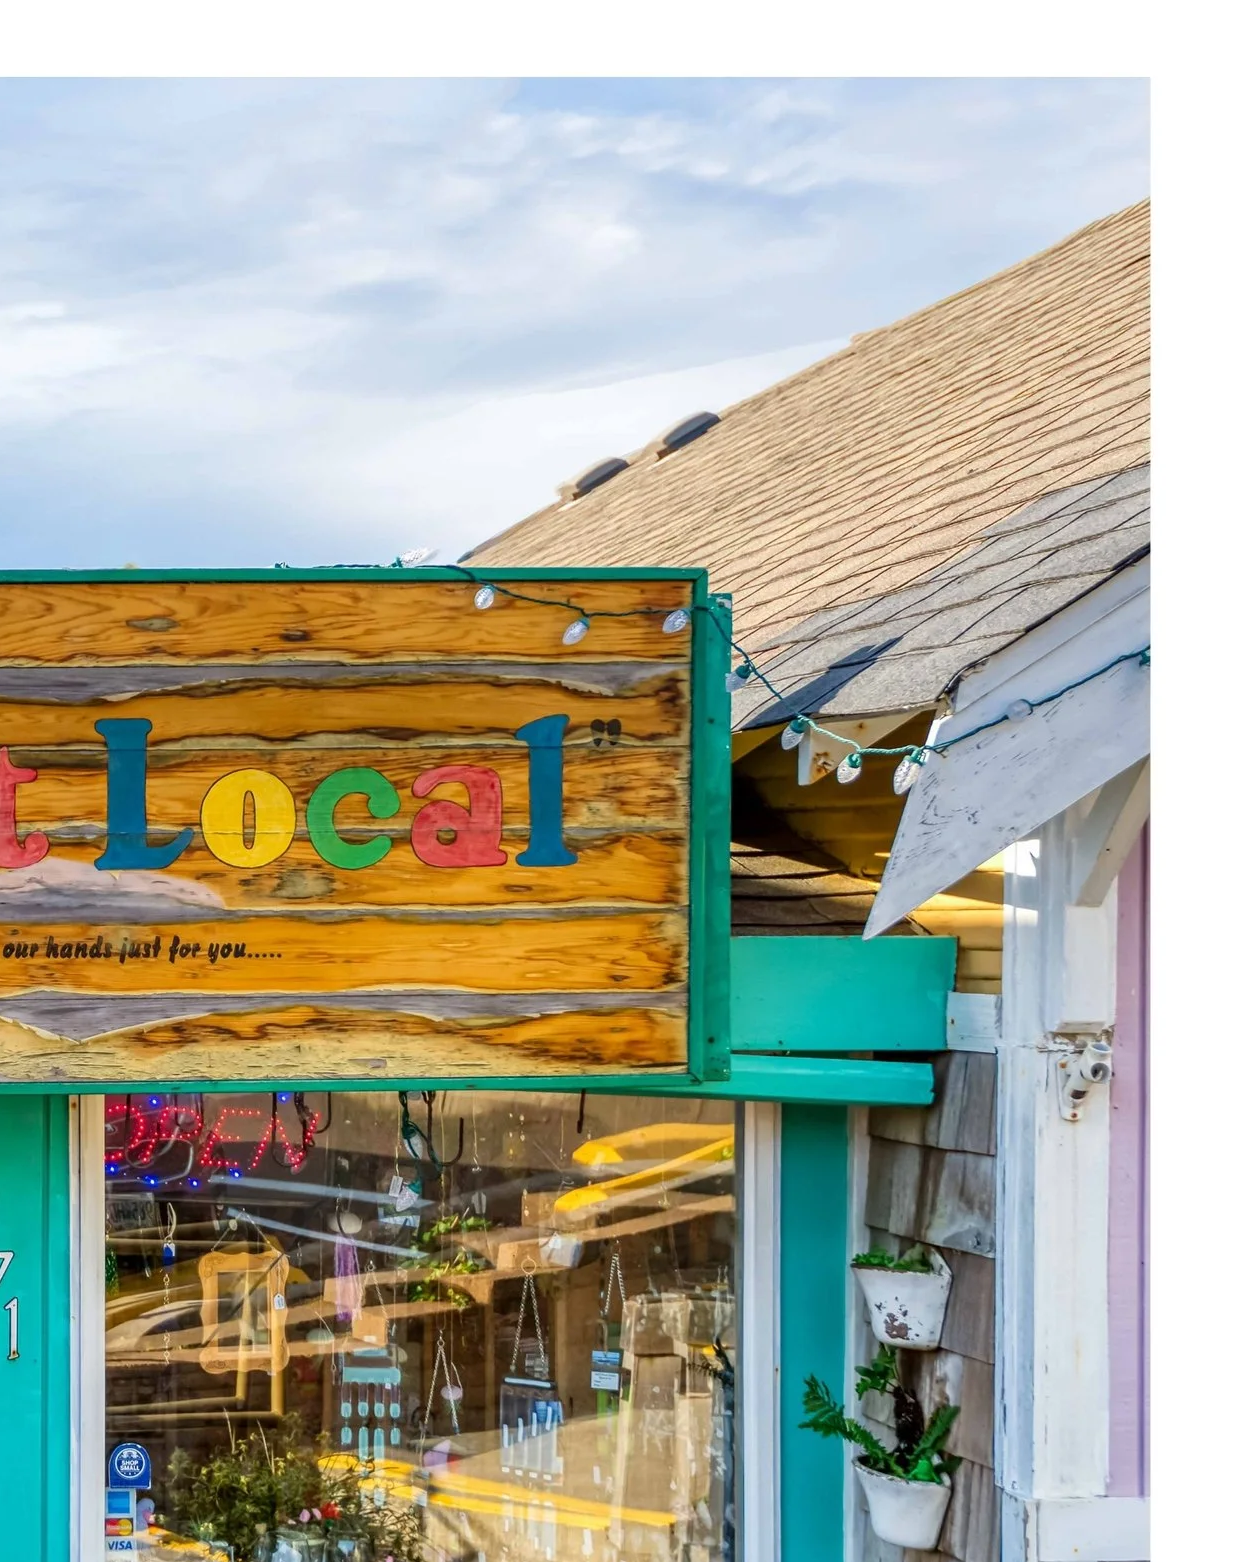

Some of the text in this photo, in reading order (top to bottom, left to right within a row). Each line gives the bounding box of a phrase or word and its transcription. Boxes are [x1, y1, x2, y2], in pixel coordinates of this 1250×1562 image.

[2, 942, 39, 959] our
[45, 935, 113, 959] hands
[119, 936, 162, 965] just
[168, 935, 201, 964] for
[104, 1104, 321, 1169] OPEN
[107, 1540, 133, 1551] VISA
